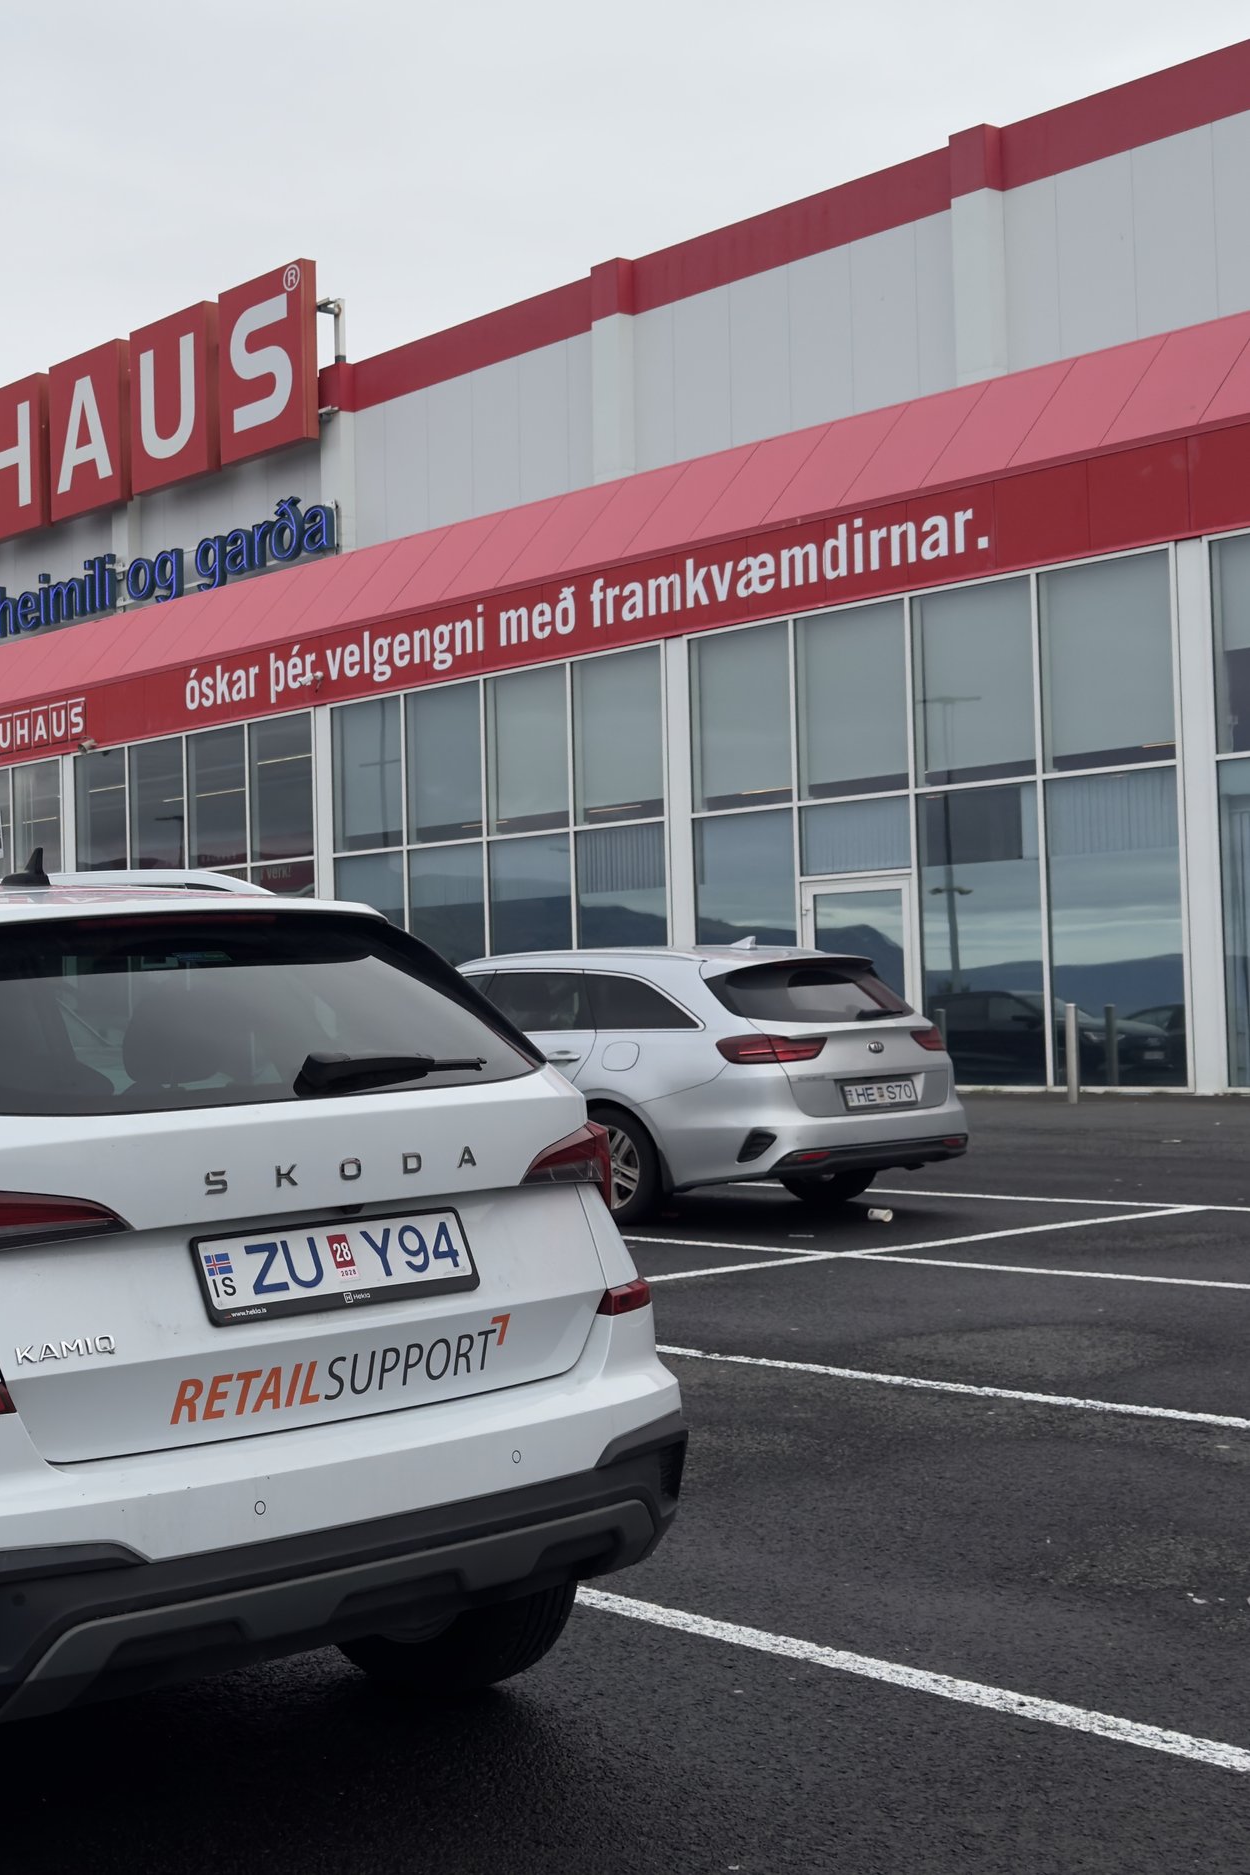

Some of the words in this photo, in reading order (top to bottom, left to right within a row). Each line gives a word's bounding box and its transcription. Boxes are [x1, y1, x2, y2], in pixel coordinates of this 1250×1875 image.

[127, 548, 183, 602] og
[196, 496, 335, 592] garða
[186, 667, 259, 711] óskar
[270, 645, 317, 703] þér
[326, 604, 485, 683] velgengni
[499, 587, 577, 647] með
[590, 508, 989, 628] framkvæmdirnar.
[886, 1083, 913, 1100] S70
[211, 1276, 237, 1298] IS
[244, 1236, 324, 1295] ZU
[333, 1242, 351, 1262] 28
[359, 1221, 460, 1277] Y94
[15, 1334, 116, 1365] KAMIQ
[170, 1328, 498, 1425] RETAILSUPPORT
